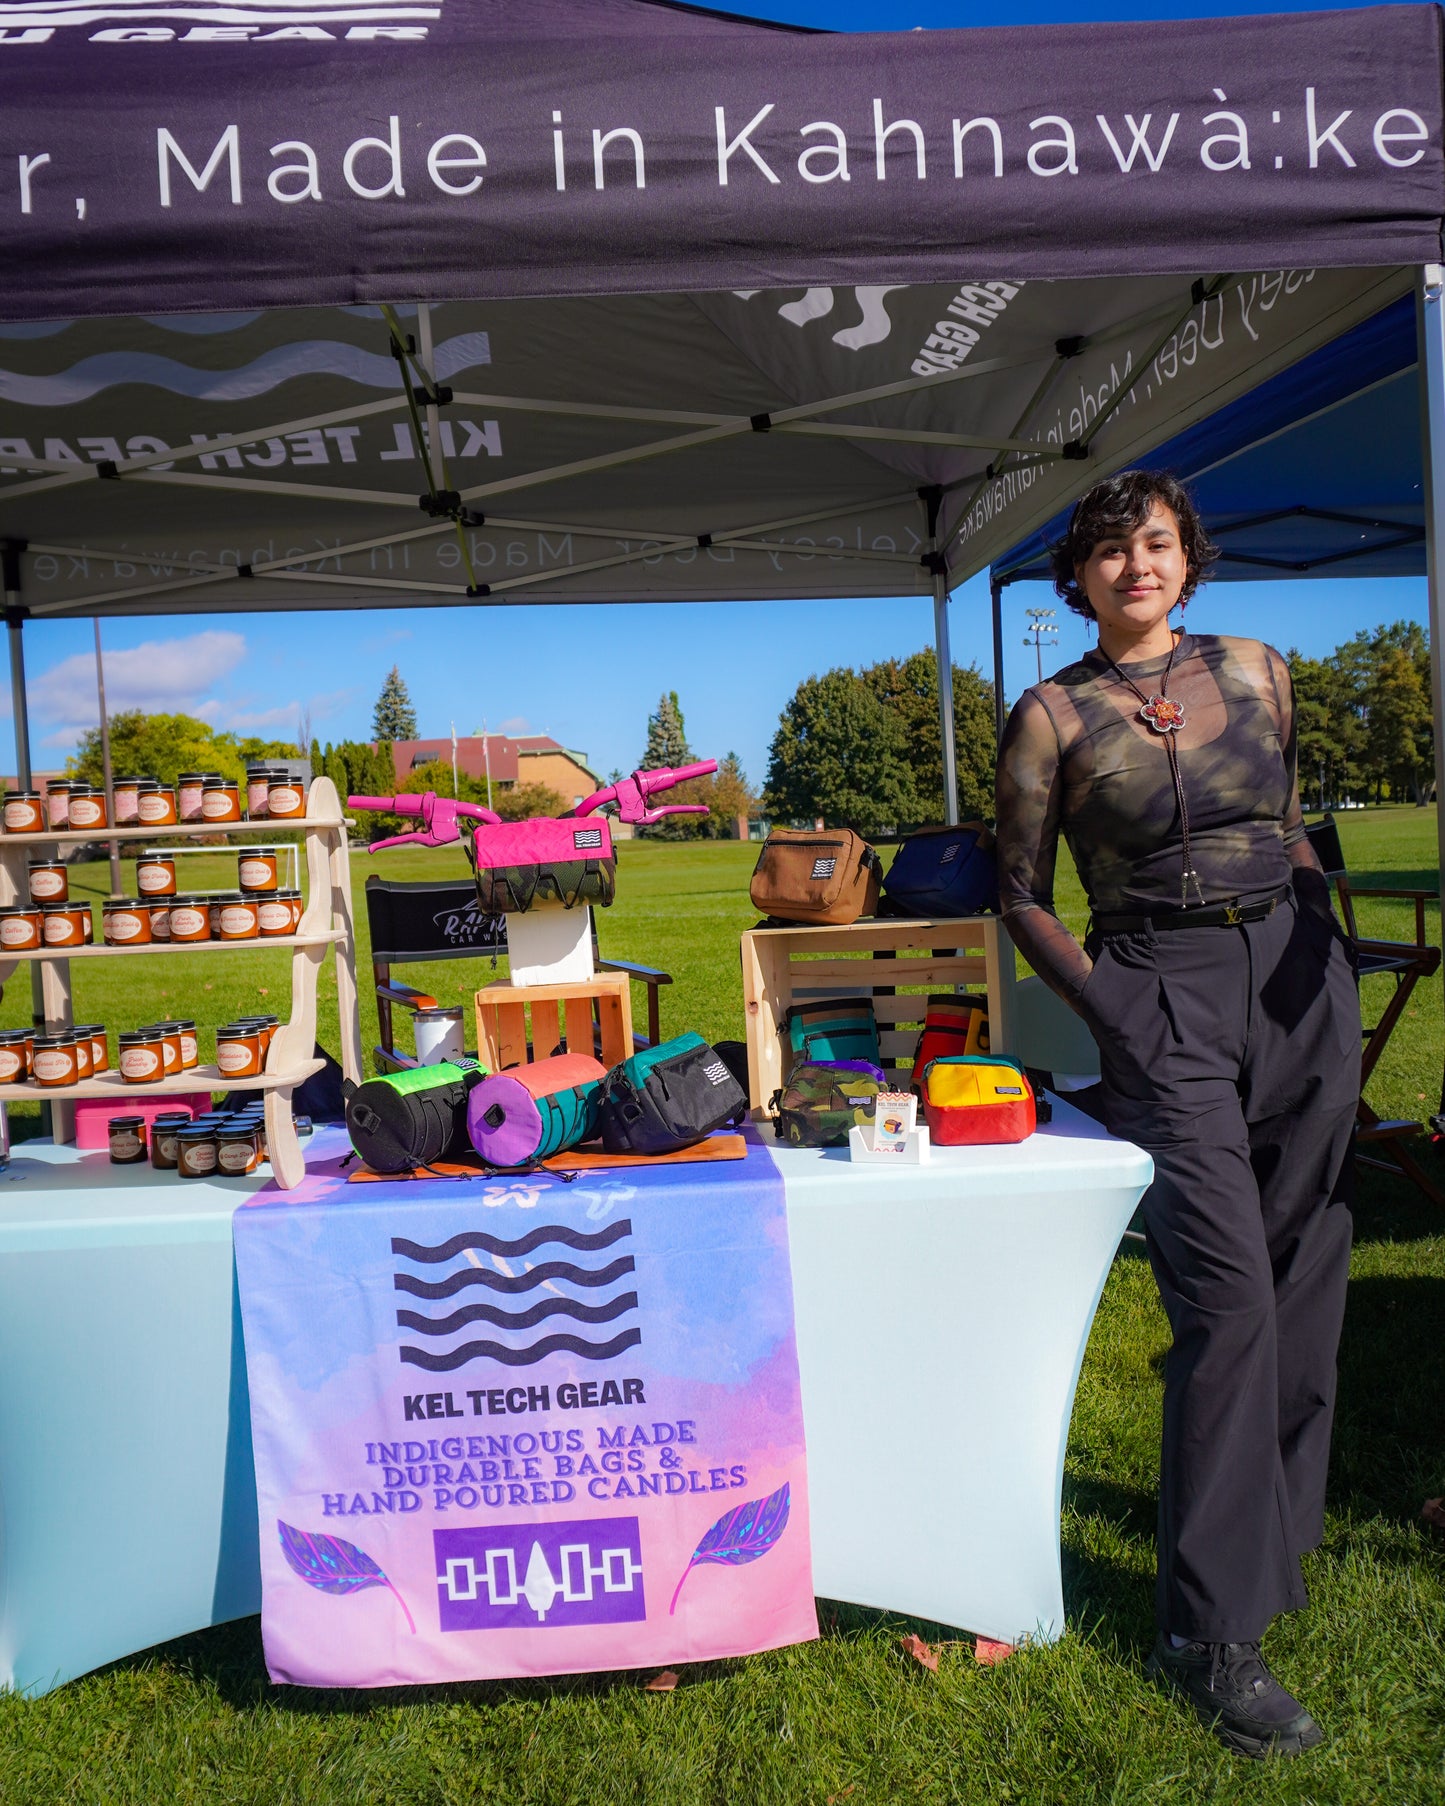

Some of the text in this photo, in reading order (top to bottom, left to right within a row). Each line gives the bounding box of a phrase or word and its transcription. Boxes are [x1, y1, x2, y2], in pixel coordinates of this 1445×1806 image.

[88, 26, 430, 43] GEAR
[157, 114, 488, 207] Made
[551, 110, 646, 191] in
[714, 86, 1430, 186] Kahnawà:ke
[450, 934, 474, 944] CAR
[403, 1377, 647, 1422] KEL TECH GEAR
[364, 1419, 697, 1466] INDIGENOUS MADE
[321, 1464, 749, 1517] HAND POURED CANDLES
[382, 1446, 683, 1490] DURABLE BAGS &
